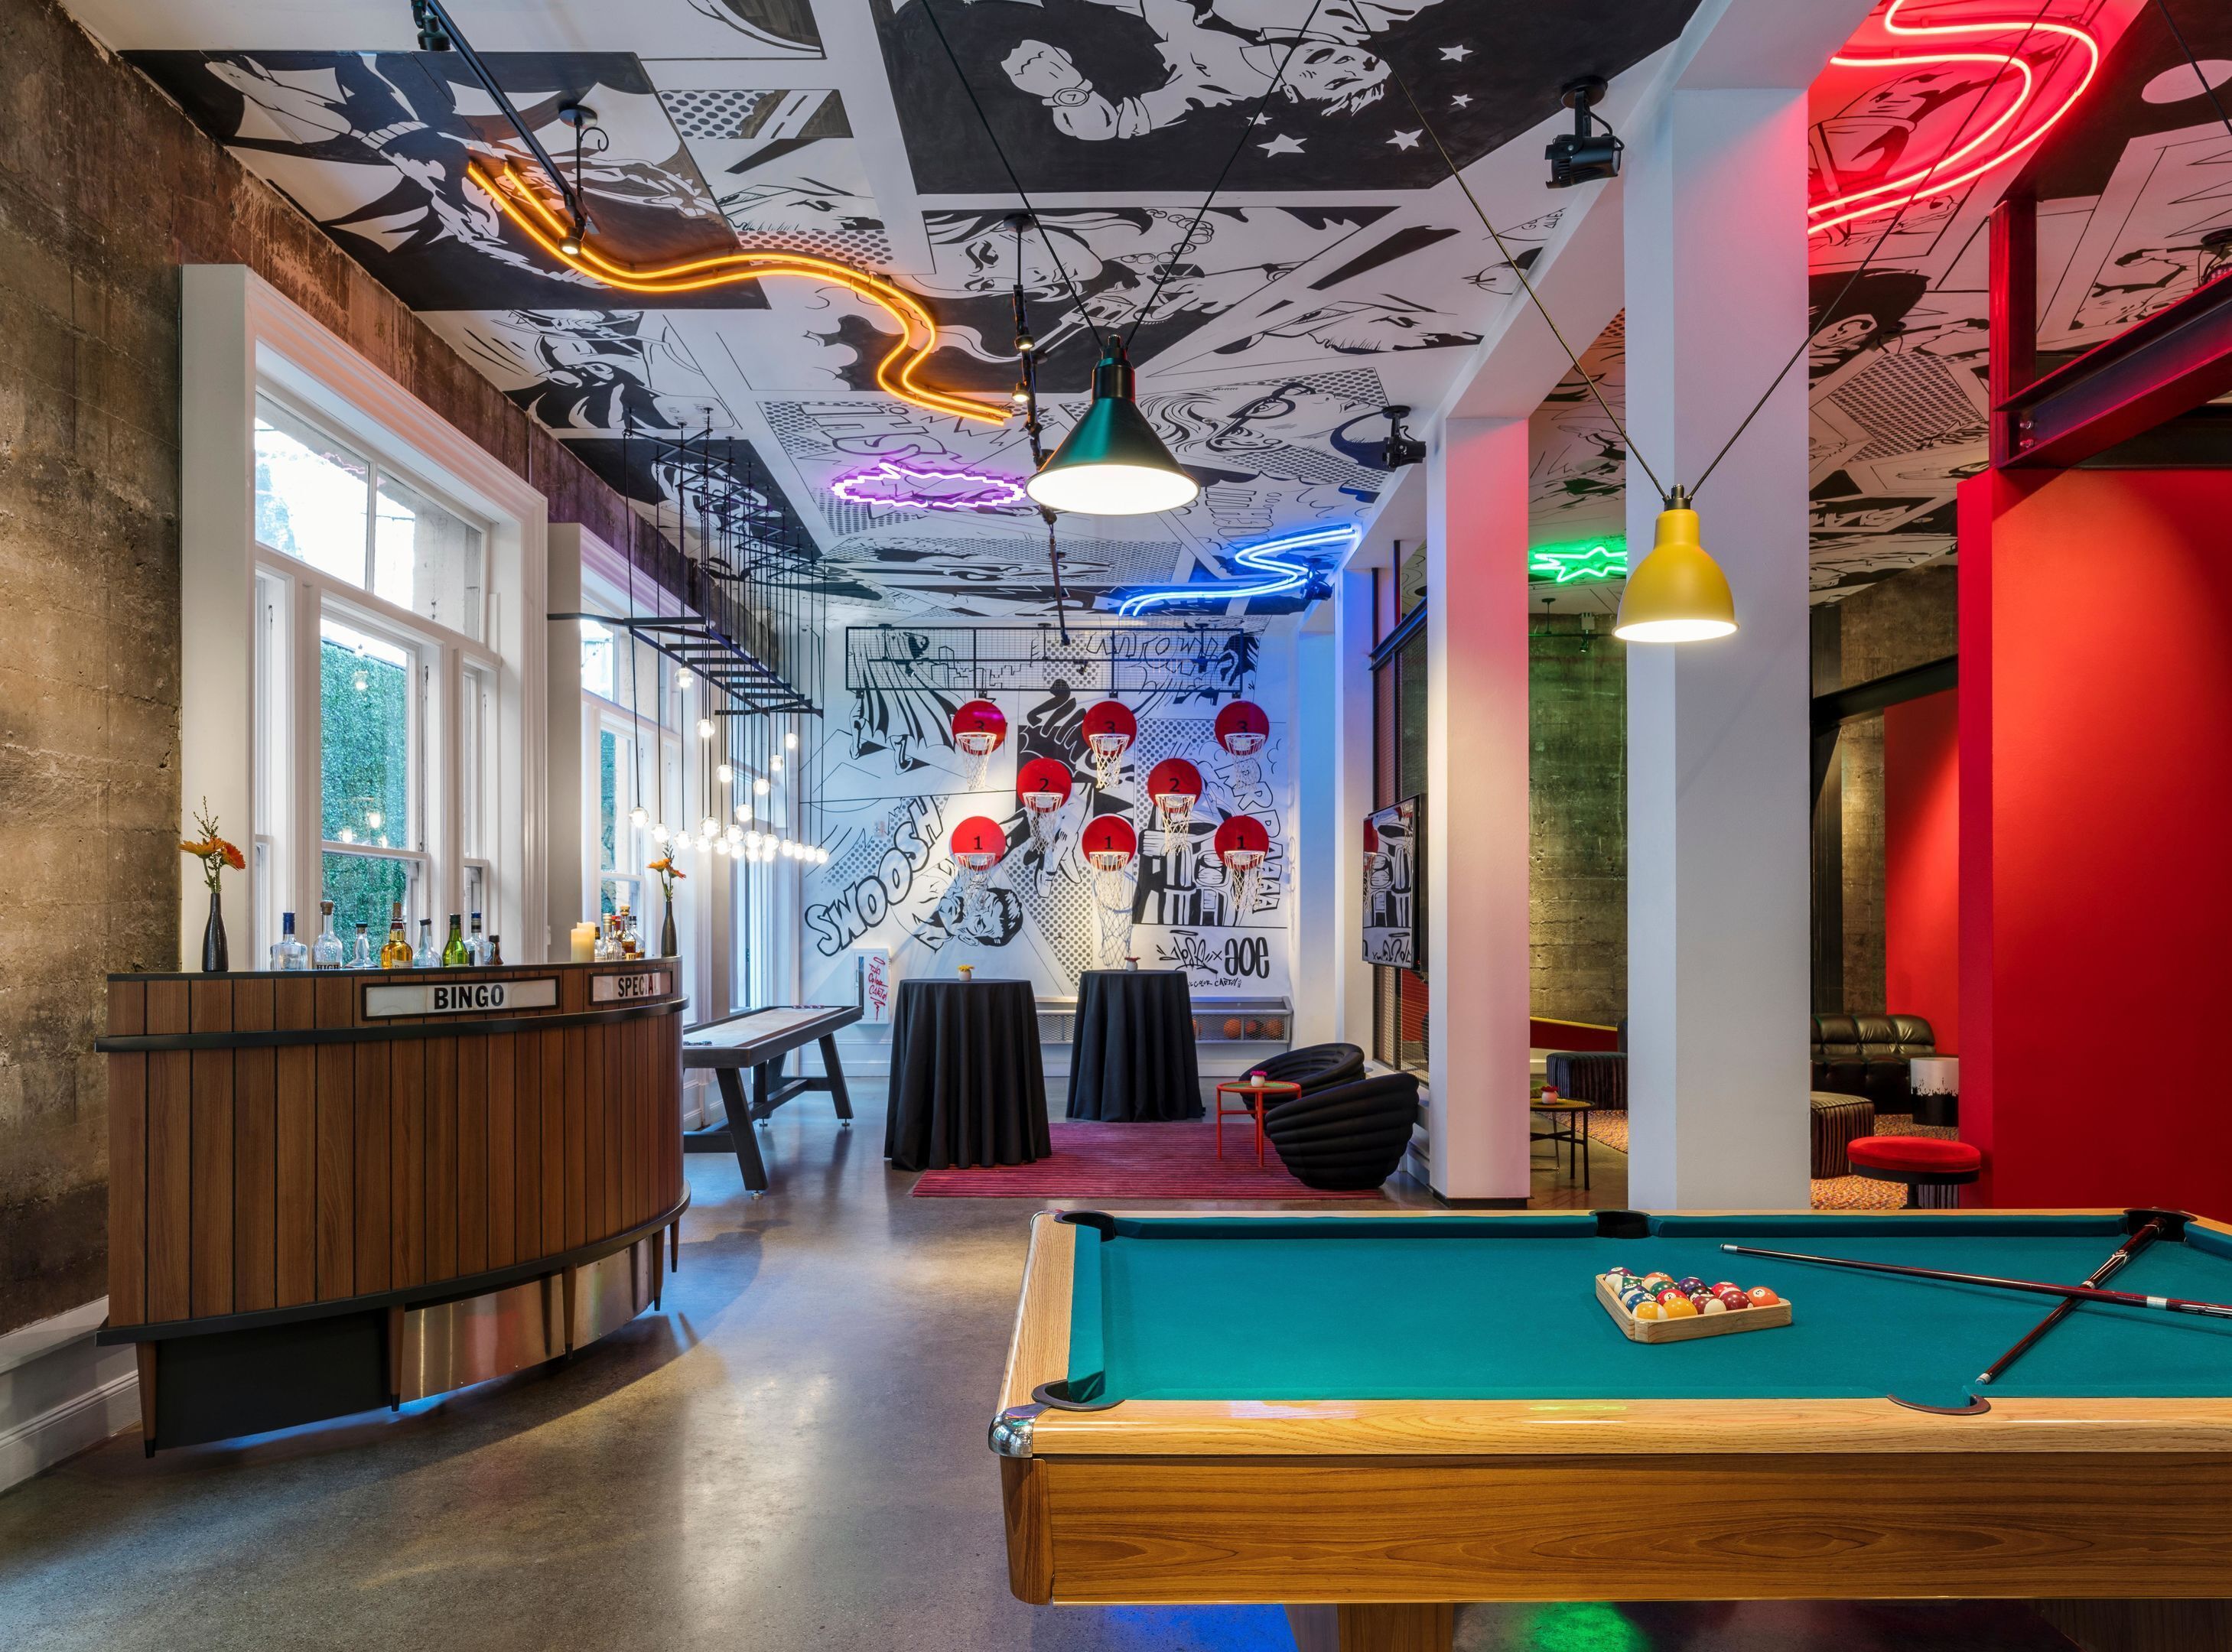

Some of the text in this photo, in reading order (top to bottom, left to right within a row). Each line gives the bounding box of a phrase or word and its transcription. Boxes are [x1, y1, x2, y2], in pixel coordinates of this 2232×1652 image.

[975, 720, 985, 732] 3
[1105, 721, 1116, 733] 3
[1237, 720, 1248, 733] 3
[1040, 778, 1050, 792] 2
[1169, 778, 1180, 792] 2
[974, 836, 983, 850] 1
[1105, 836, 1114, 849] 1
[1237, 836, 1246, 849] 1
[805, 795, 944, 957] SWOOSH
[434, 984, 504, 1010] BINGO
